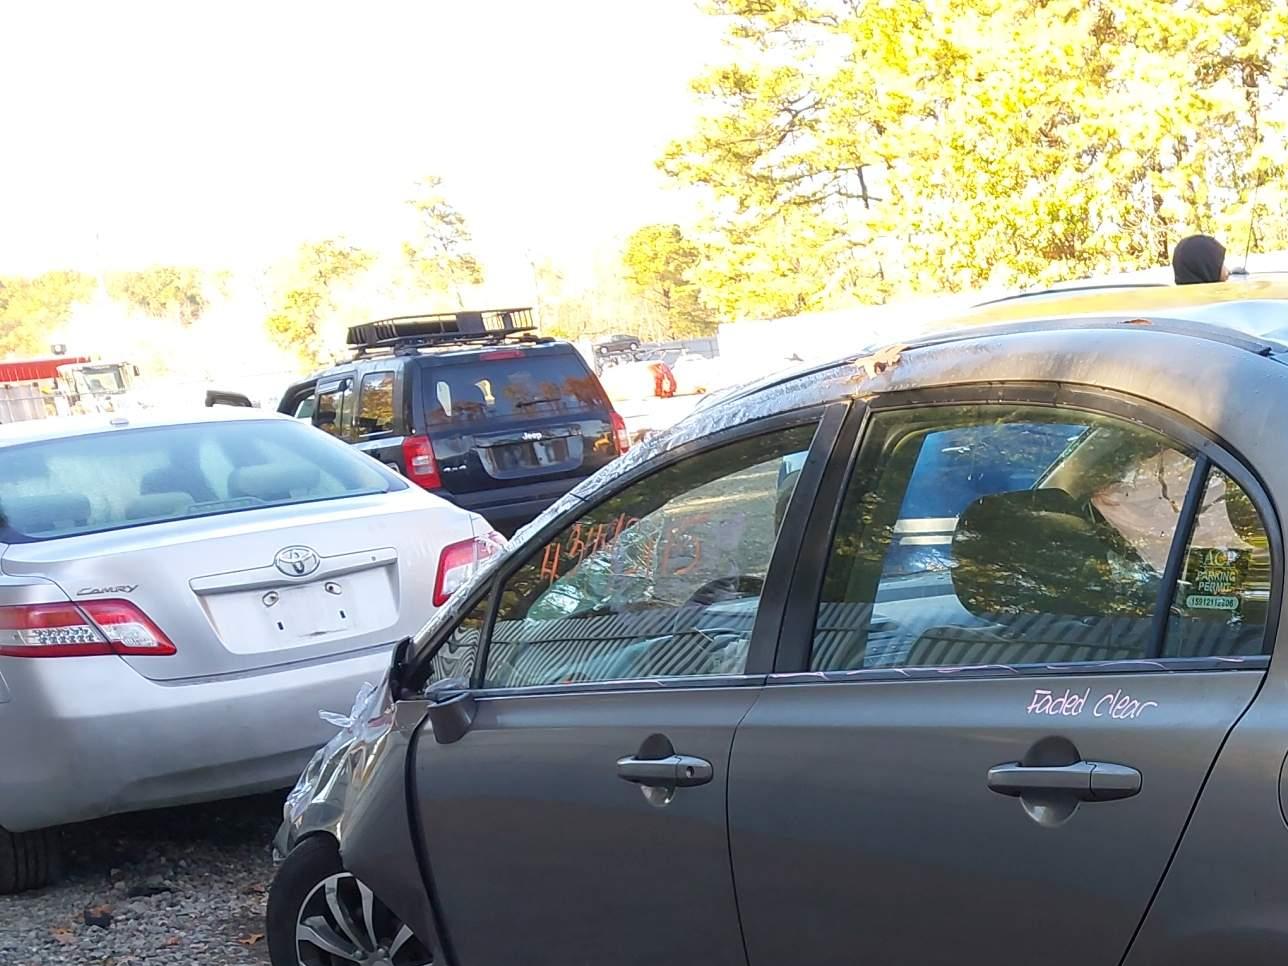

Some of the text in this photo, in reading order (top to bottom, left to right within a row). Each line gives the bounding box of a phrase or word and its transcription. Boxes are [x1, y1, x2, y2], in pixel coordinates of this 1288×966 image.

[521, 431, 542, 441] Jeep
[1198, 570, 1236, 583] PARKING
[76, 584, 139, 596] CAMRY
[1026, 688, 1090, 716] Faded
